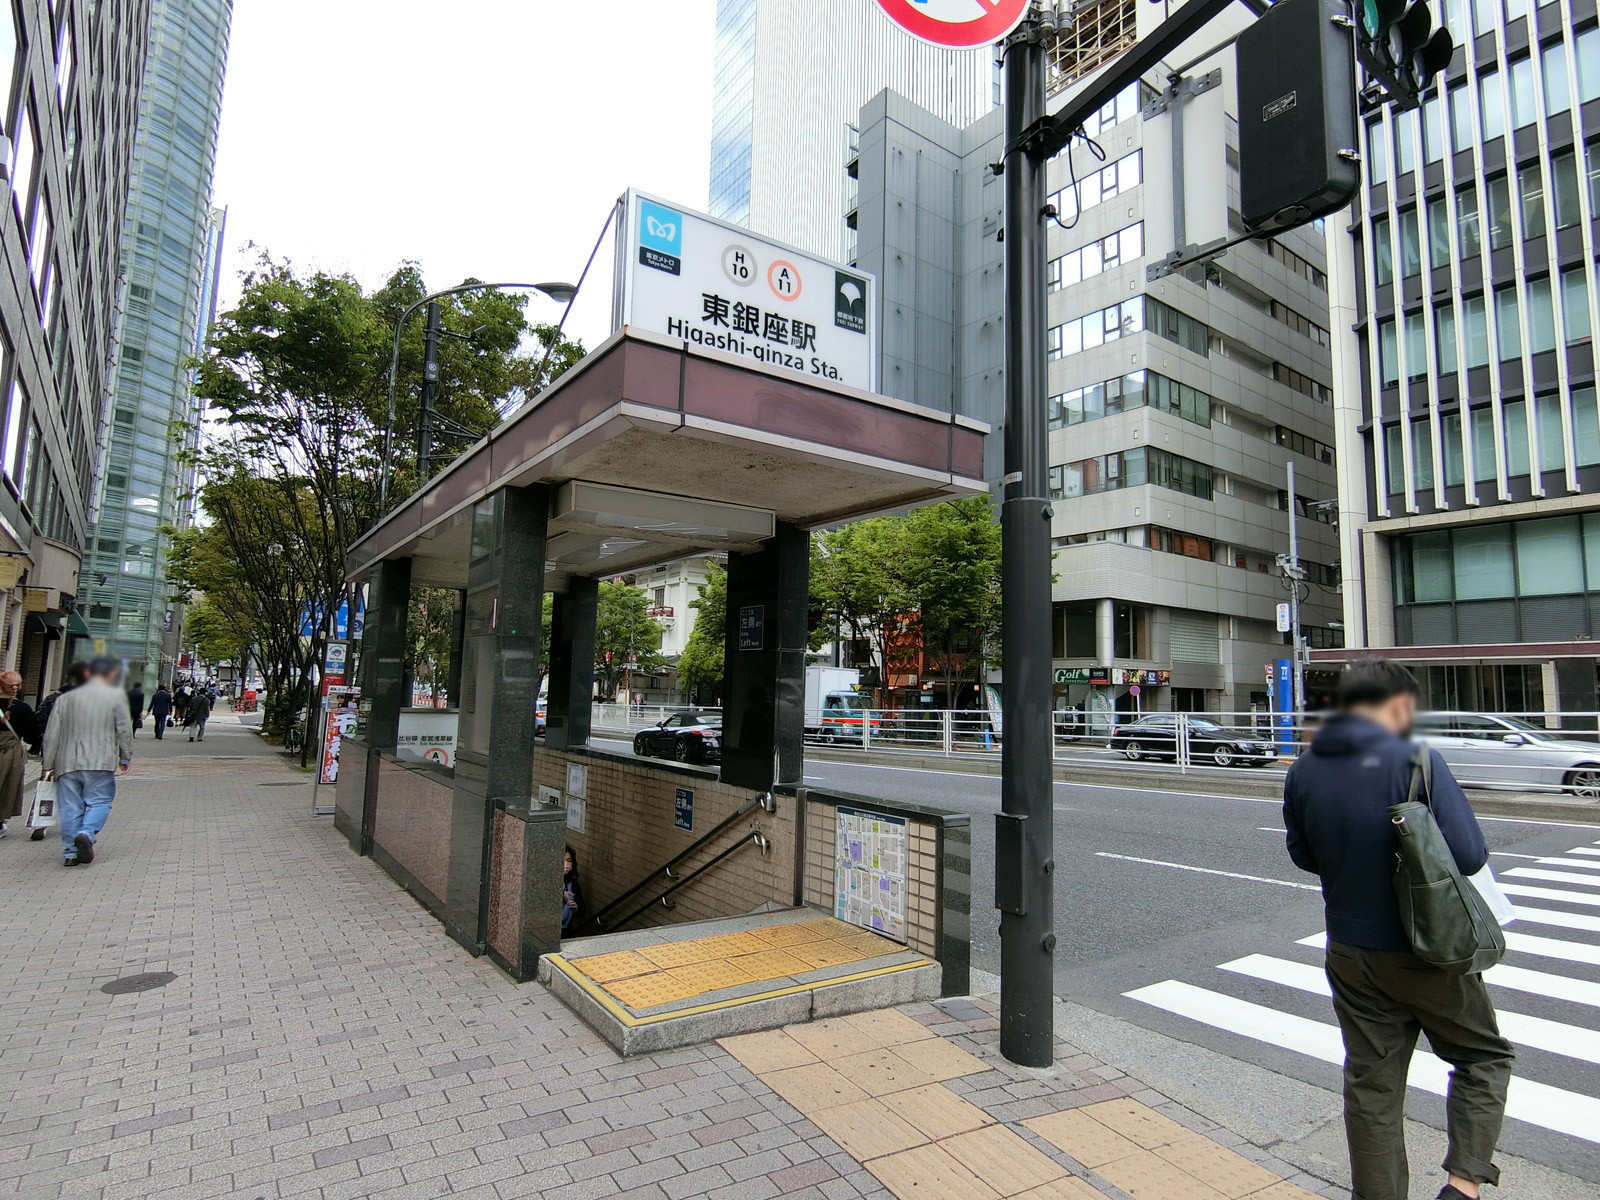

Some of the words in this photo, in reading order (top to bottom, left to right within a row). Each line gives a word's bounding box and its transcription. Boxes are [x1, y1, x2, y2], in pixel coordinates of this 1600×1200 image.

[646, 252, 675, 267] 東京メトロ
[647, 259, 660, 267] Tokyo
[660, 262, 673, 271] Metro
[735, 251, 745, 264] H
[732, 263, 749, 279] 10
[780, 268, 790, 280] A
[778, 279, 792, 293] 11
[701, 292, 816, 353] 東銀座駅
[837, 311, 864, 326] 都営地下鉄
[810, 357, 844, 381] Sta.
[740, 639, 752, 647] Left
[1055, 668, 1082, 684] Golf
